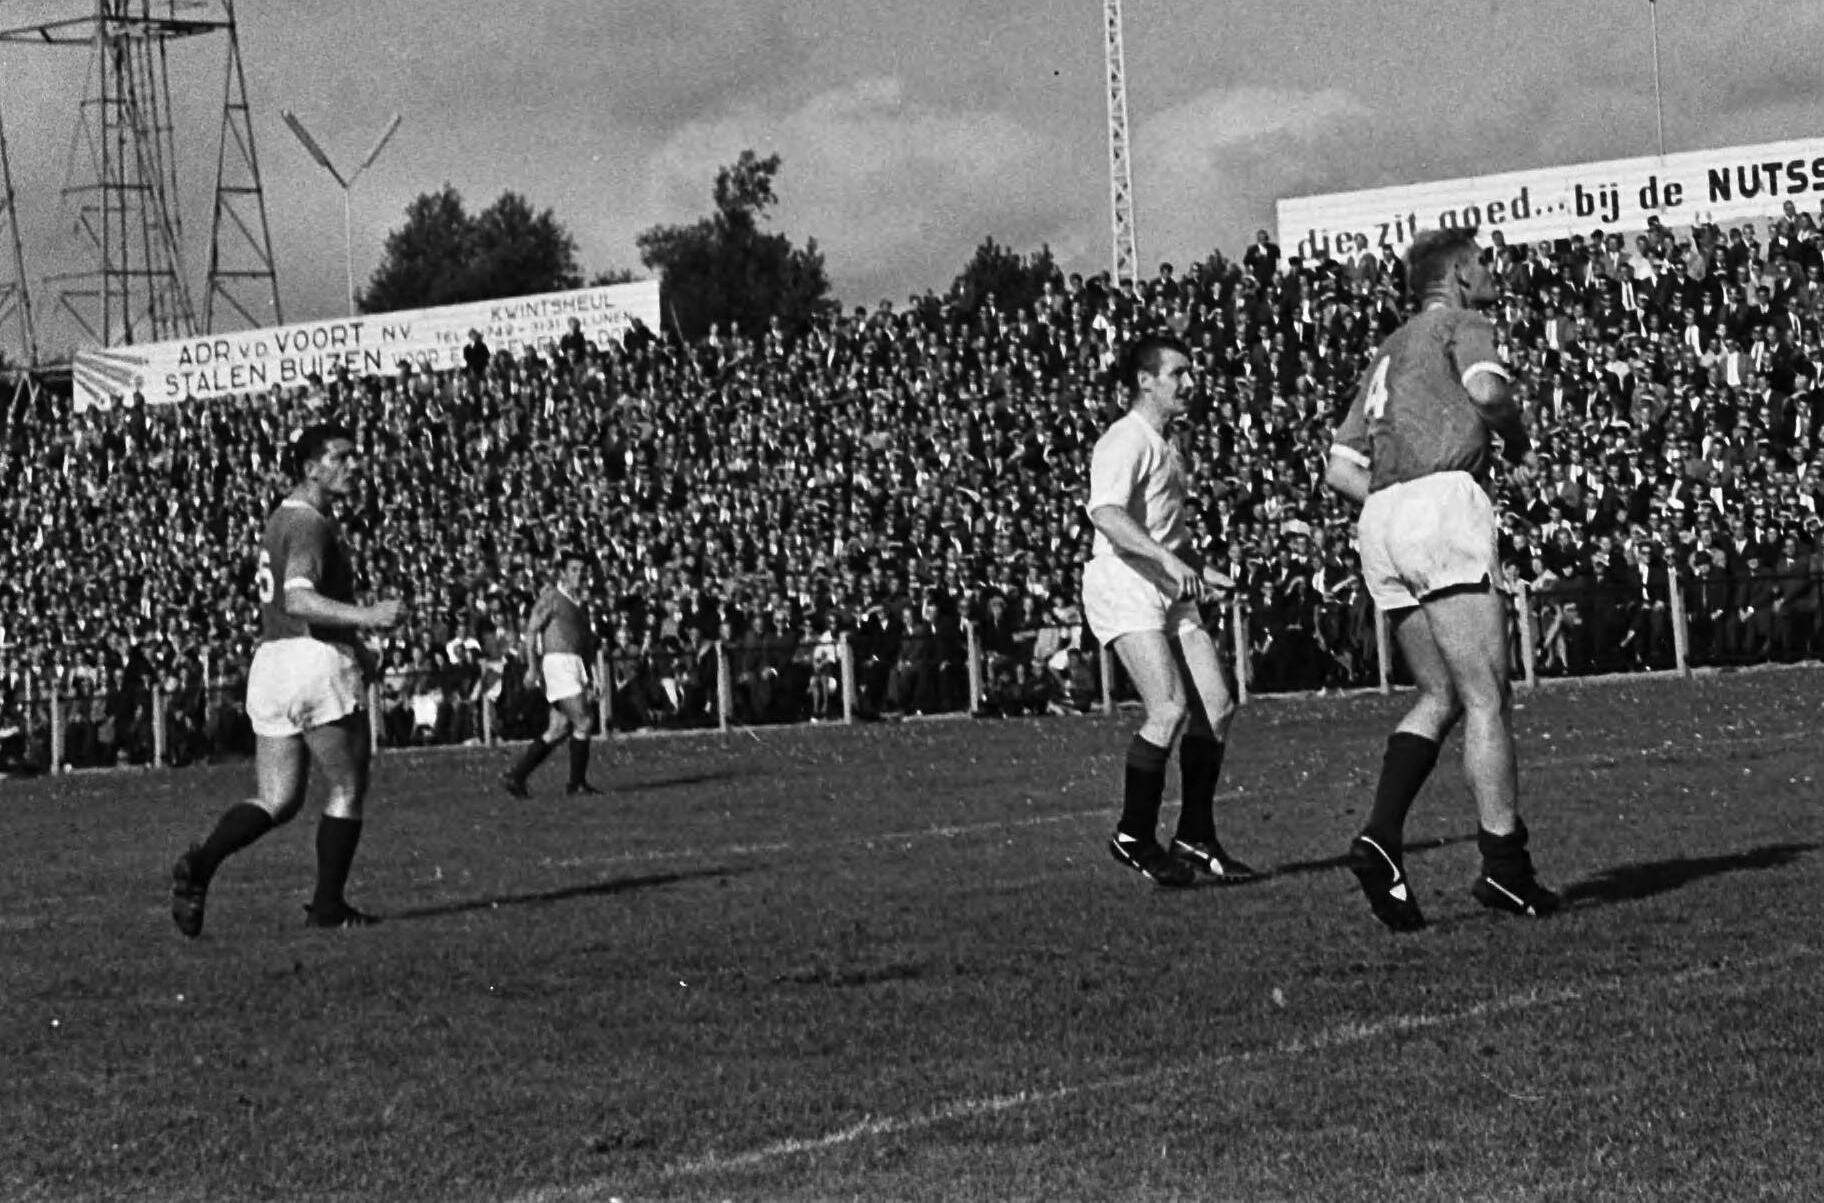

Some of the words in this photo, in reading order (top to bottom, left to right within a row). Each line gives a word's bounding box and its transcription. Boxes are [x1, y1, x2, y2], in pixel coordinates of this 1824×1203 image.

[1297, 228, 1353, 260] die
[1375, 212, 1417, 247] zit
[1638, 175, 1683, 210] de
[165, 361, 267, 396] STALEN
[280, 348, 382, 382] BUIZEN
[178, 339, 231, 367] ADR
[274, 321, 364, 354] VOORT
[1364, 355, 1391, 419] 4
